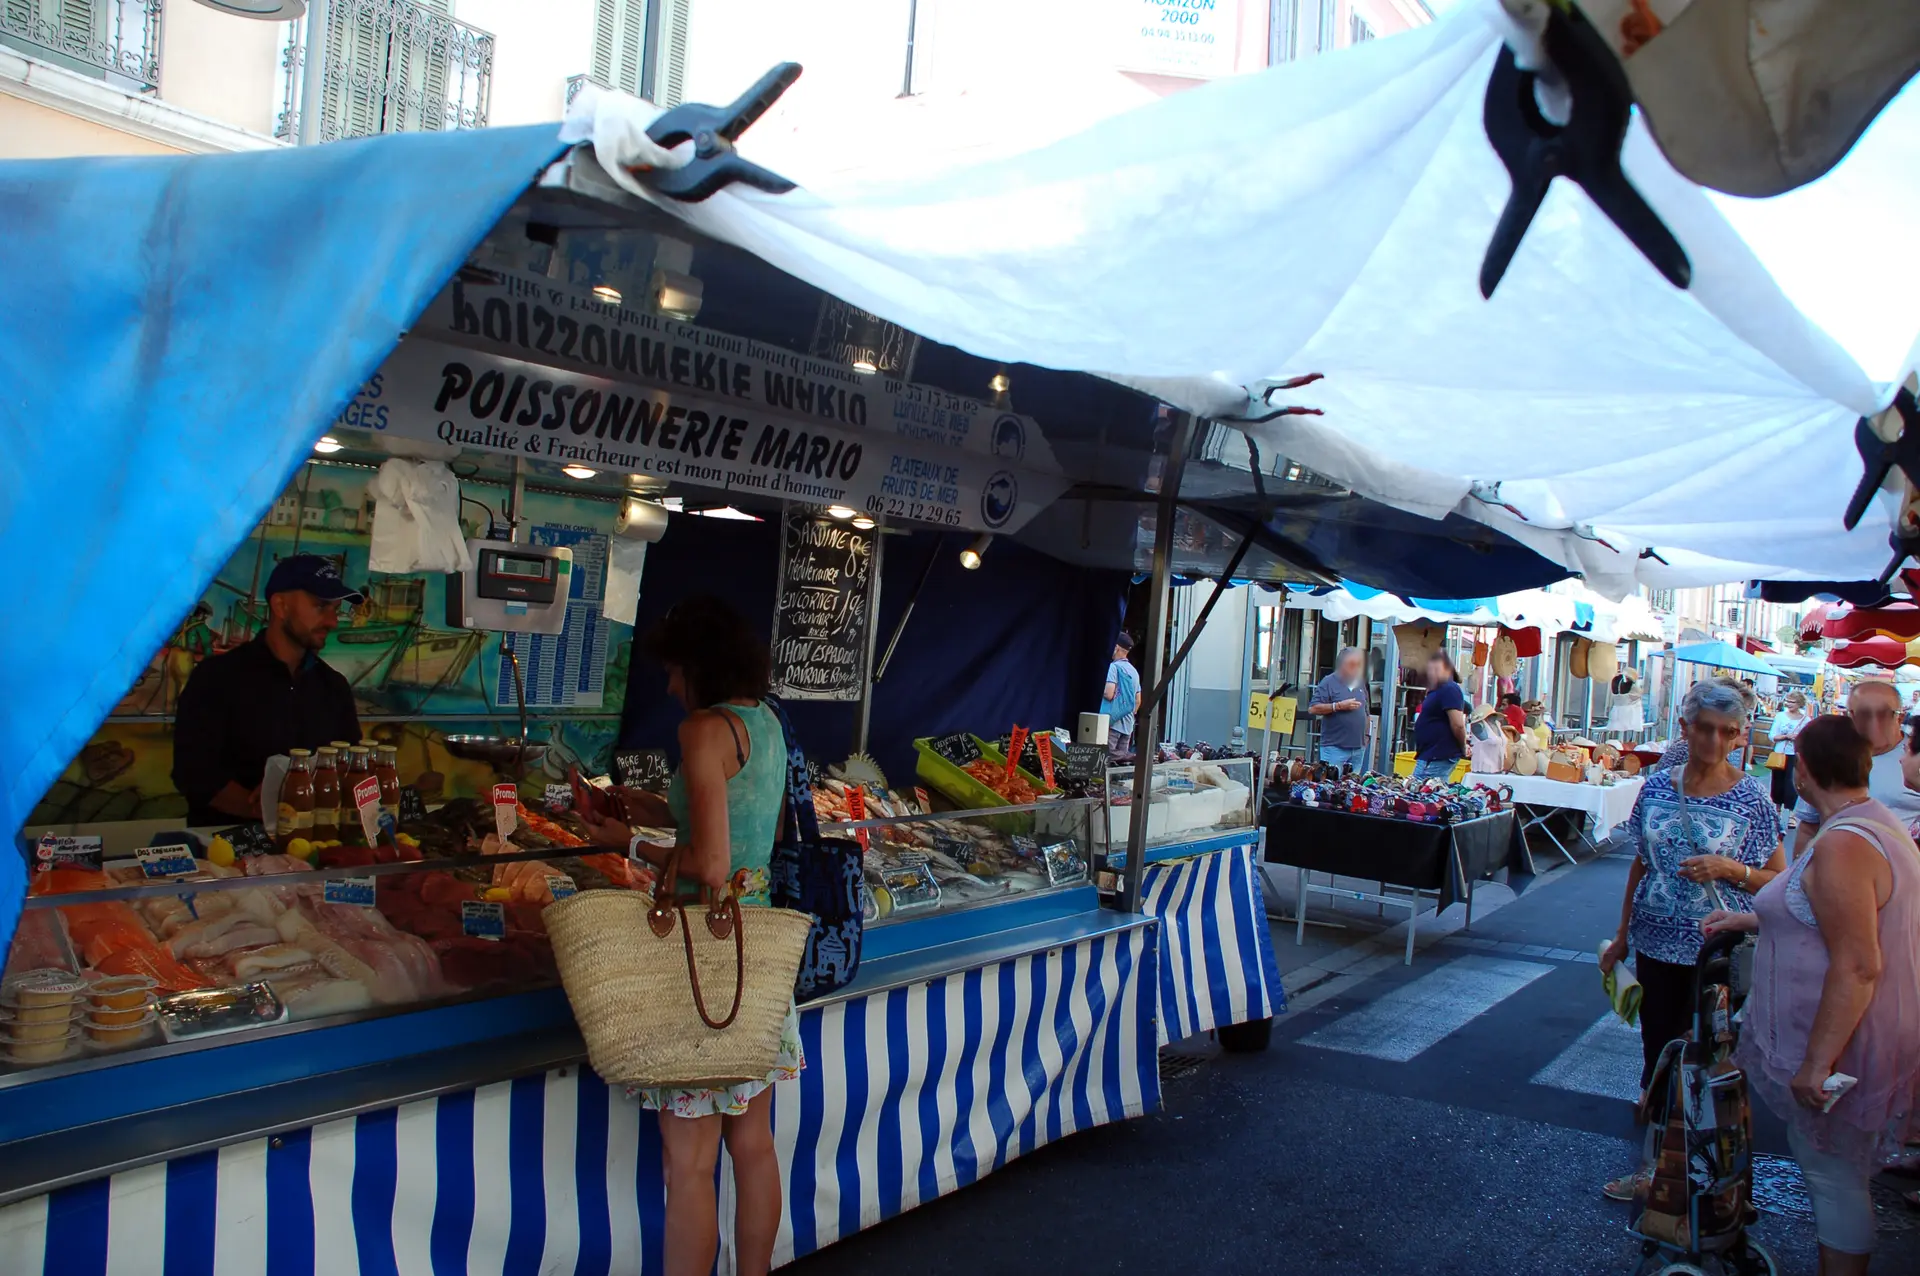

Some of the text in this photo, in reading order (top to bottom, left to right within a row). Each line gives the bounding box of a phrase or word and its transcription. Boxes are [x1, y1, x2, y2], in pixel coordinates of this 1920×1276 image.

[1161, 9, 1199, 25] 2000
[434, 362, 863, 481] POISSONNERIE MARIO
[437, 420, 846, 500] Qualité & Fraîcheur c'est mon point d'honneur
[891, 455, 959, 485] PLATEAUX DE
[881, 475, 959, 504] FRUITS DE MER
[866, 495, 961, 525] 06 22 12 29 65
[788, 516, 850, 550] SARDINE
[780, 591, 840, 611] ENCORNET
[776, 637, 858, 664] THON ESPADON
[357, 782, 379, 801] Promo
[495, 789, 516, 800] Promo
